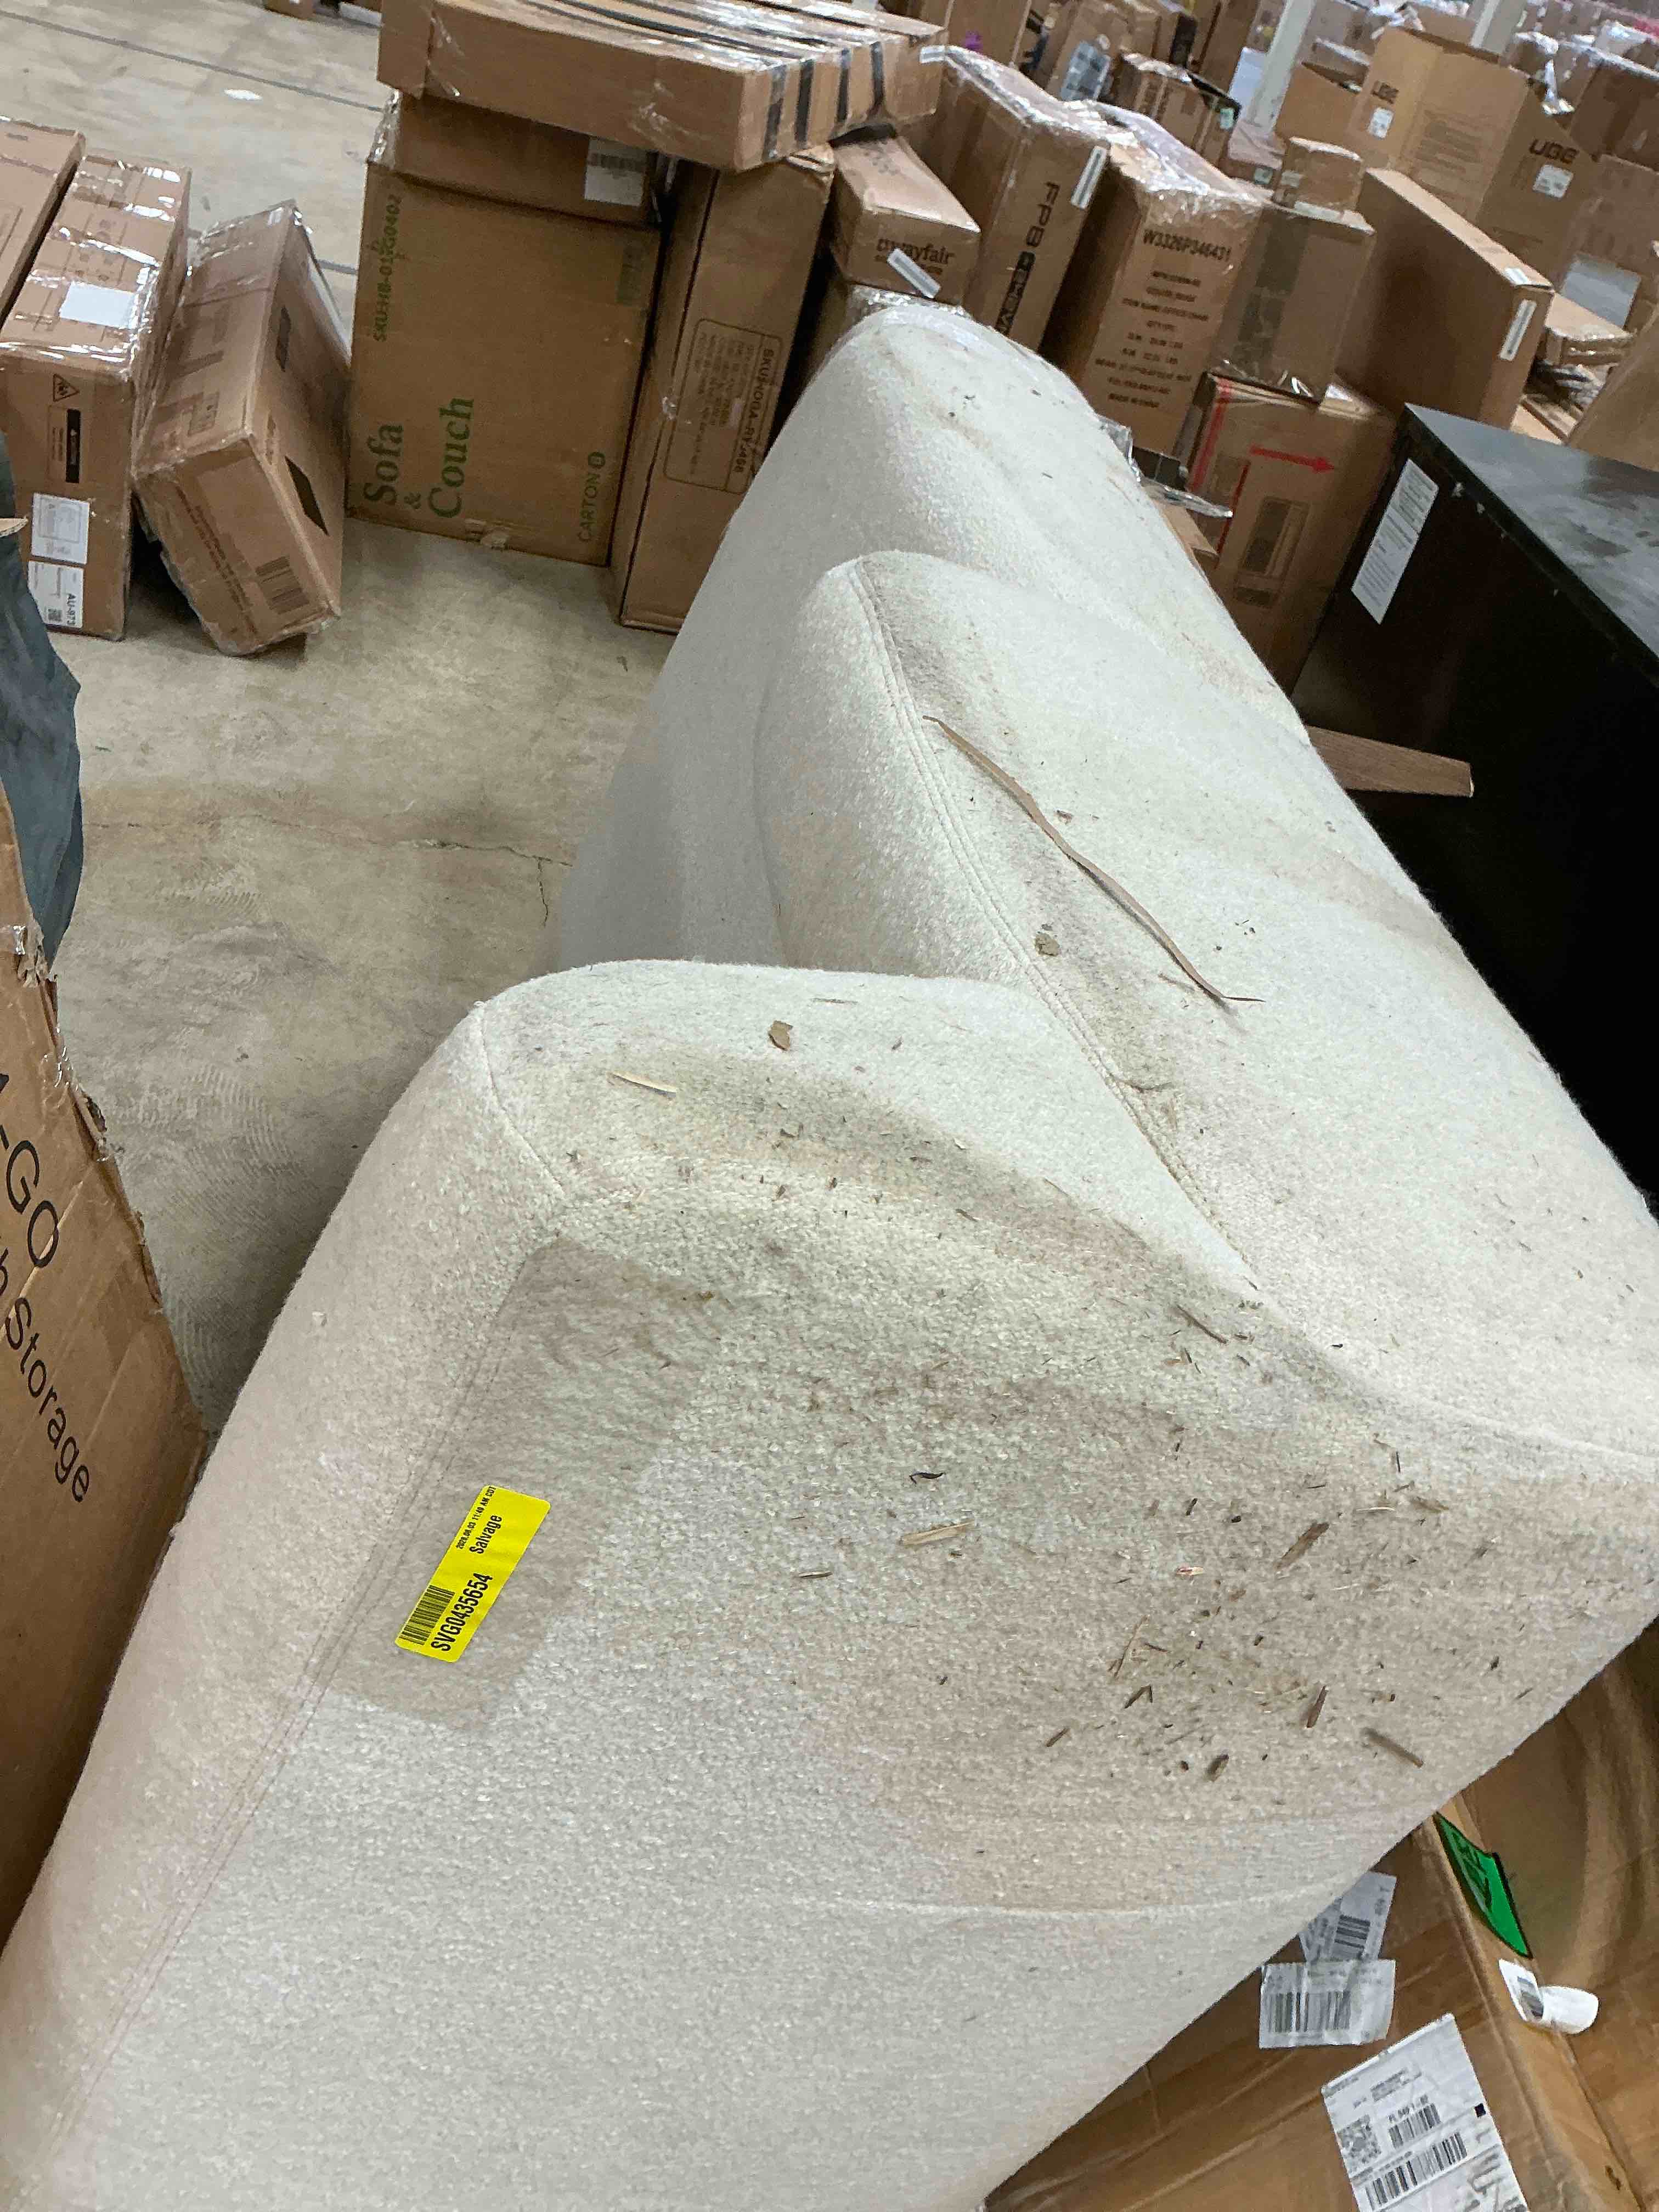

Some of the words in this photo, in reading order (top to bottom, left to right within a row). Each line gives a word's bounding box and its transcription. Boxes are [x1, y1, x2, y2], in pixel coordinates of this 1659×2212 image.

[363, 423, 404, 505] Sofa
[428, 397, 475, 519] Couch
[404, 490, 422, 510] &
[577, 473, 601, 542] CARTON
[5, 1296, 91, 1503] Storage
[469, 1515, 503, 1555] Salvage
[431, 1572, 494, 1652] SVG0435654
